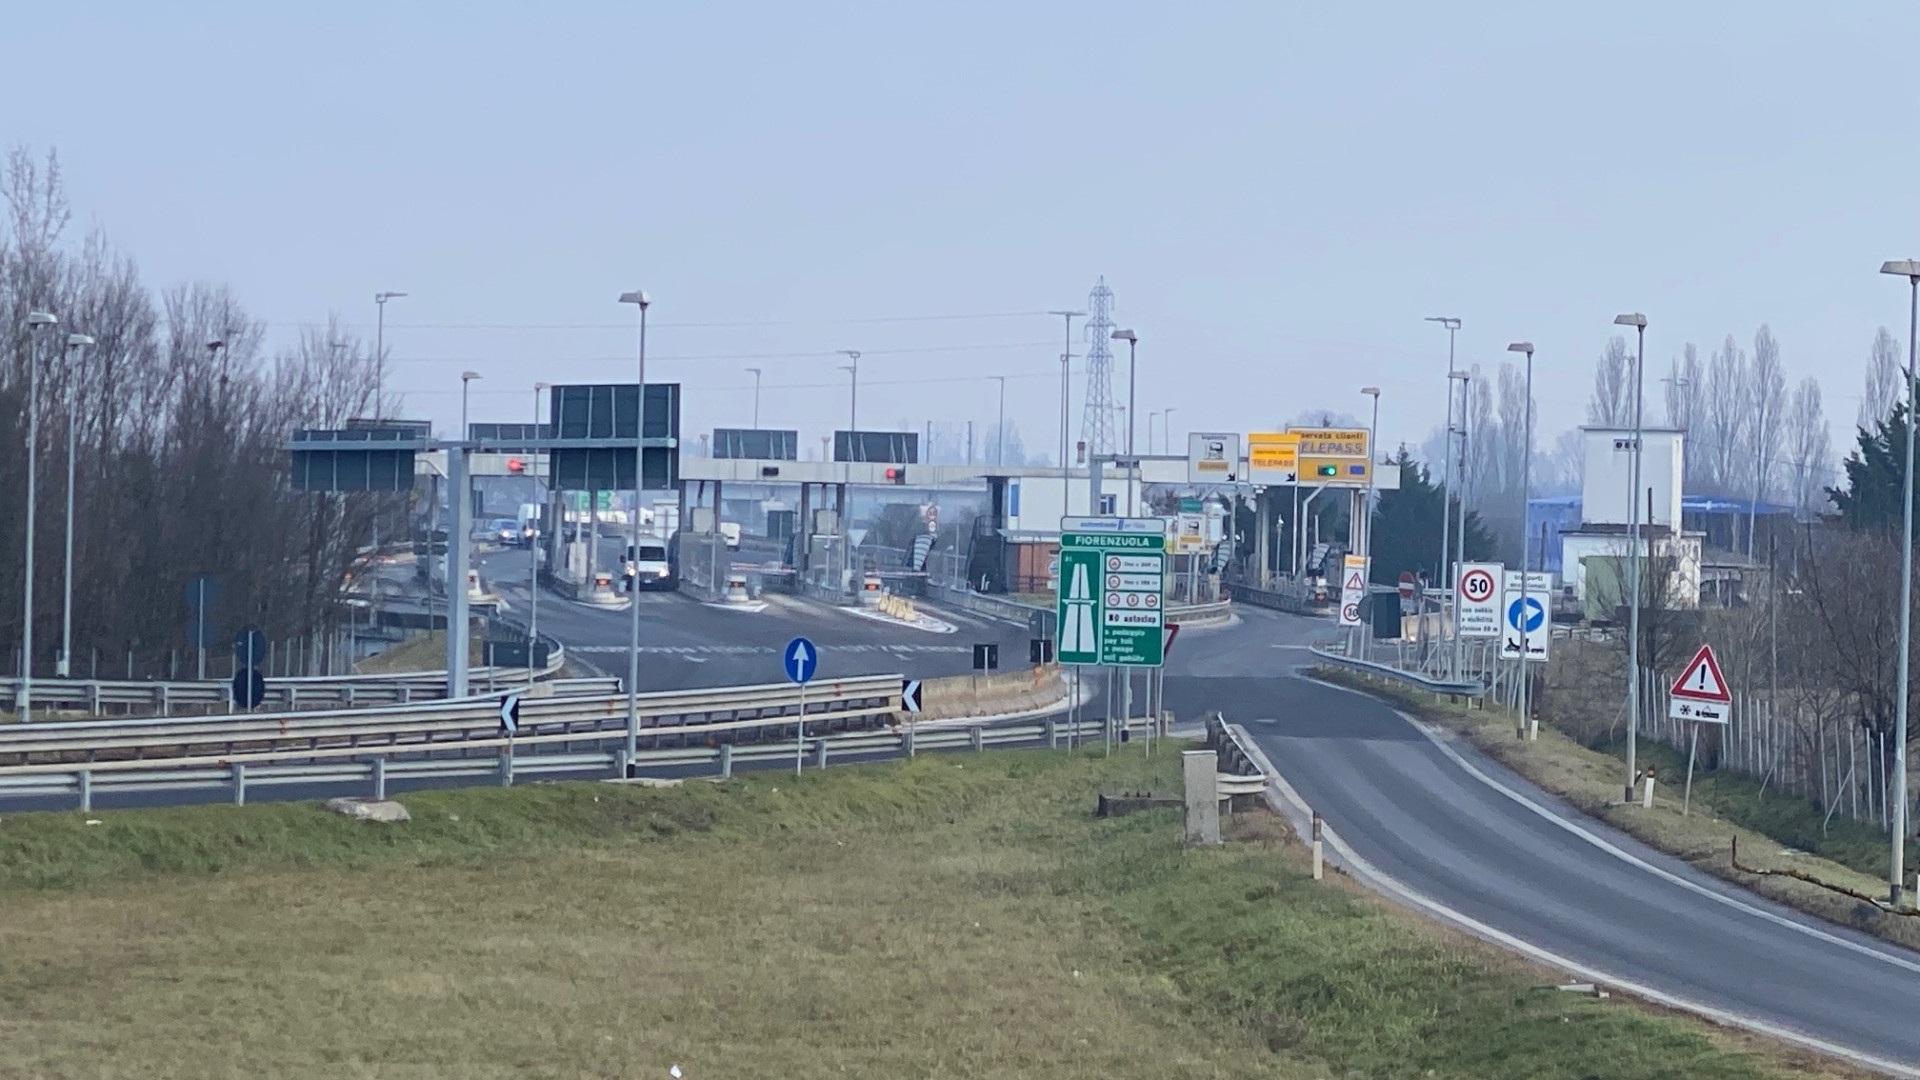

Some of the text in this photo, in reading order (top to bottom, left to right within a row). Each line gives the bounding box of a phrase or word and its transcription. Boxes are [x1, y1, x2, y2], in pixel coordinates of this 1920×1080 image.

[1301, 441, 1363, 454] ELEPASS
[1075, 536, 1150, 546] FIORENZUOLA
[1470, 579, 1488, 593] 50
[1124, 615, 1157, 624] autostop
